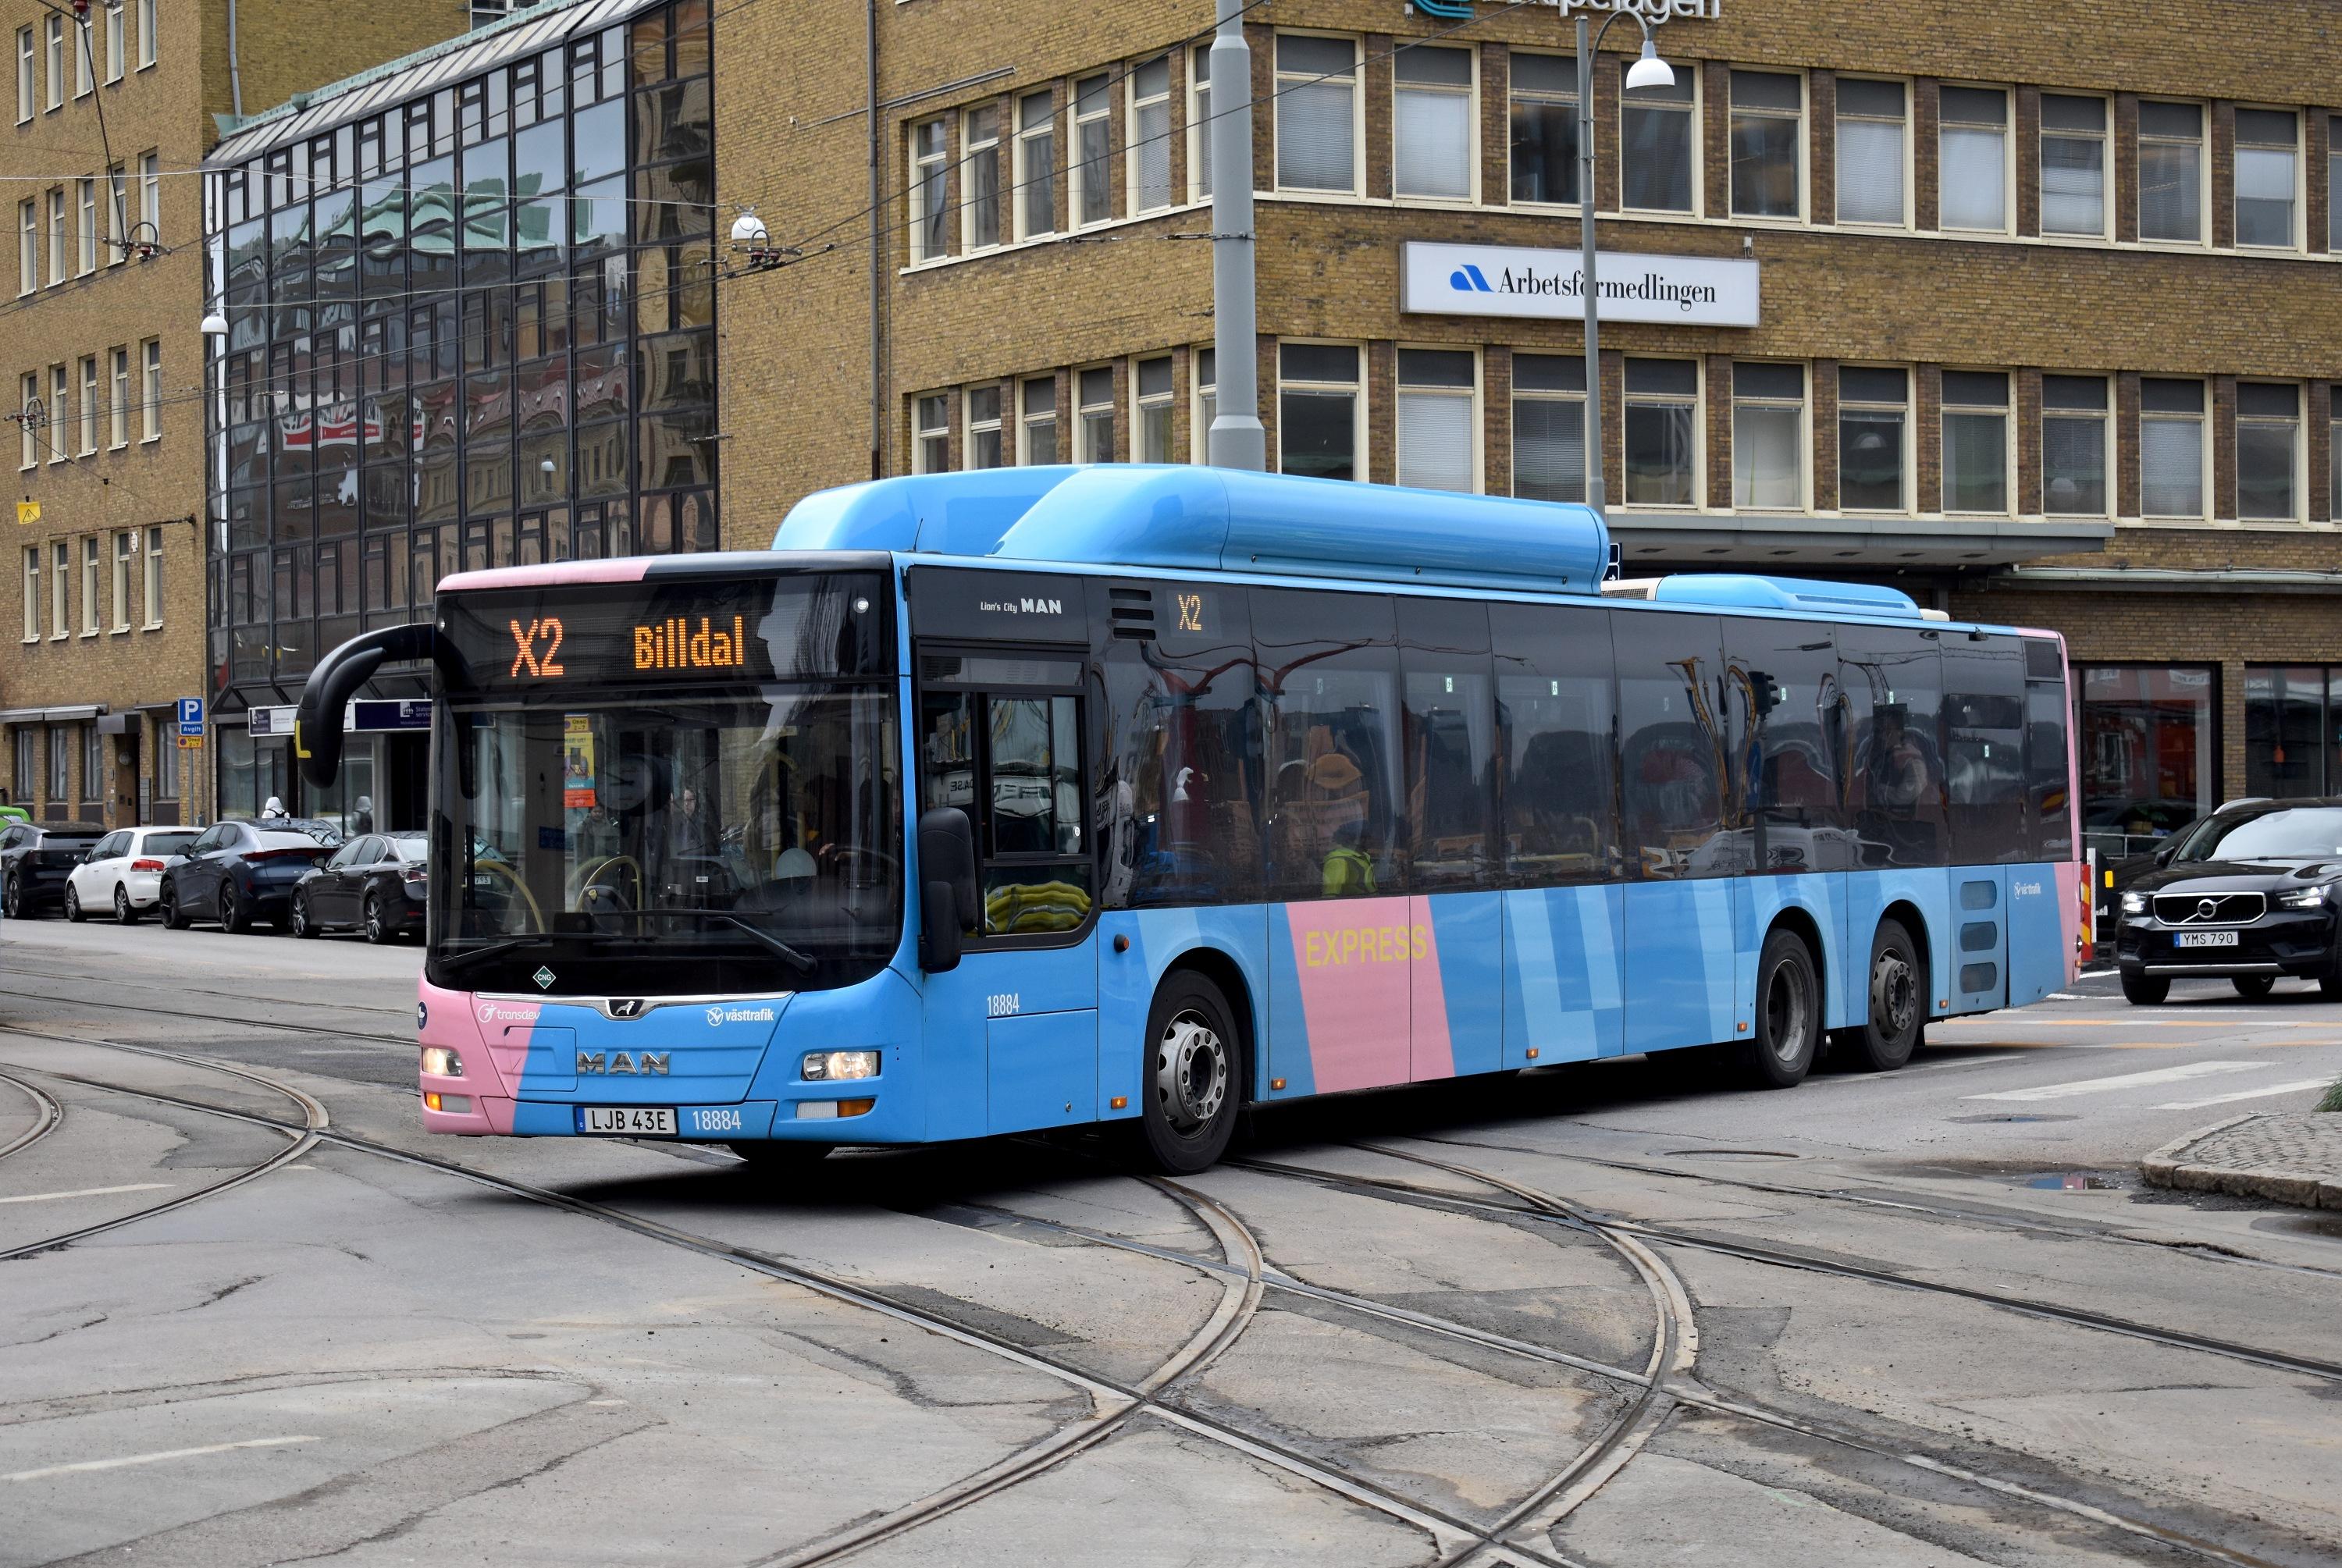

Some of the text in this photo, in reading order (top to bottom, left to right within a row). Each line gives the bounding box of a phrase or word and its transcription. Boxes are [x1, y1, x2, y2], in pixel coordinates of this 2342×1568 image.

[980, 598, 1062, 614] Lion's City MAN
[1178, 594, 1202, 631] X2
[511, 615, 743, 677] X2 Billdal
[185, 700, 199, 720] P
[1305, 924, 1428, 967] EXPRESS
[2184, 933, 2233, 945] YMS 790
[987, 993, 1020, 1015] 18884
[497, 1009, 541, 1020] transdev
[725, 1008, 774, 1022] västtrafik
[578, 1051, 671, 1075] MAN
[592, 1110, 625, 1130] LJB
[632, 1111, 667, 1130] 43E
[692, 1110, 742, 1131] 18884
